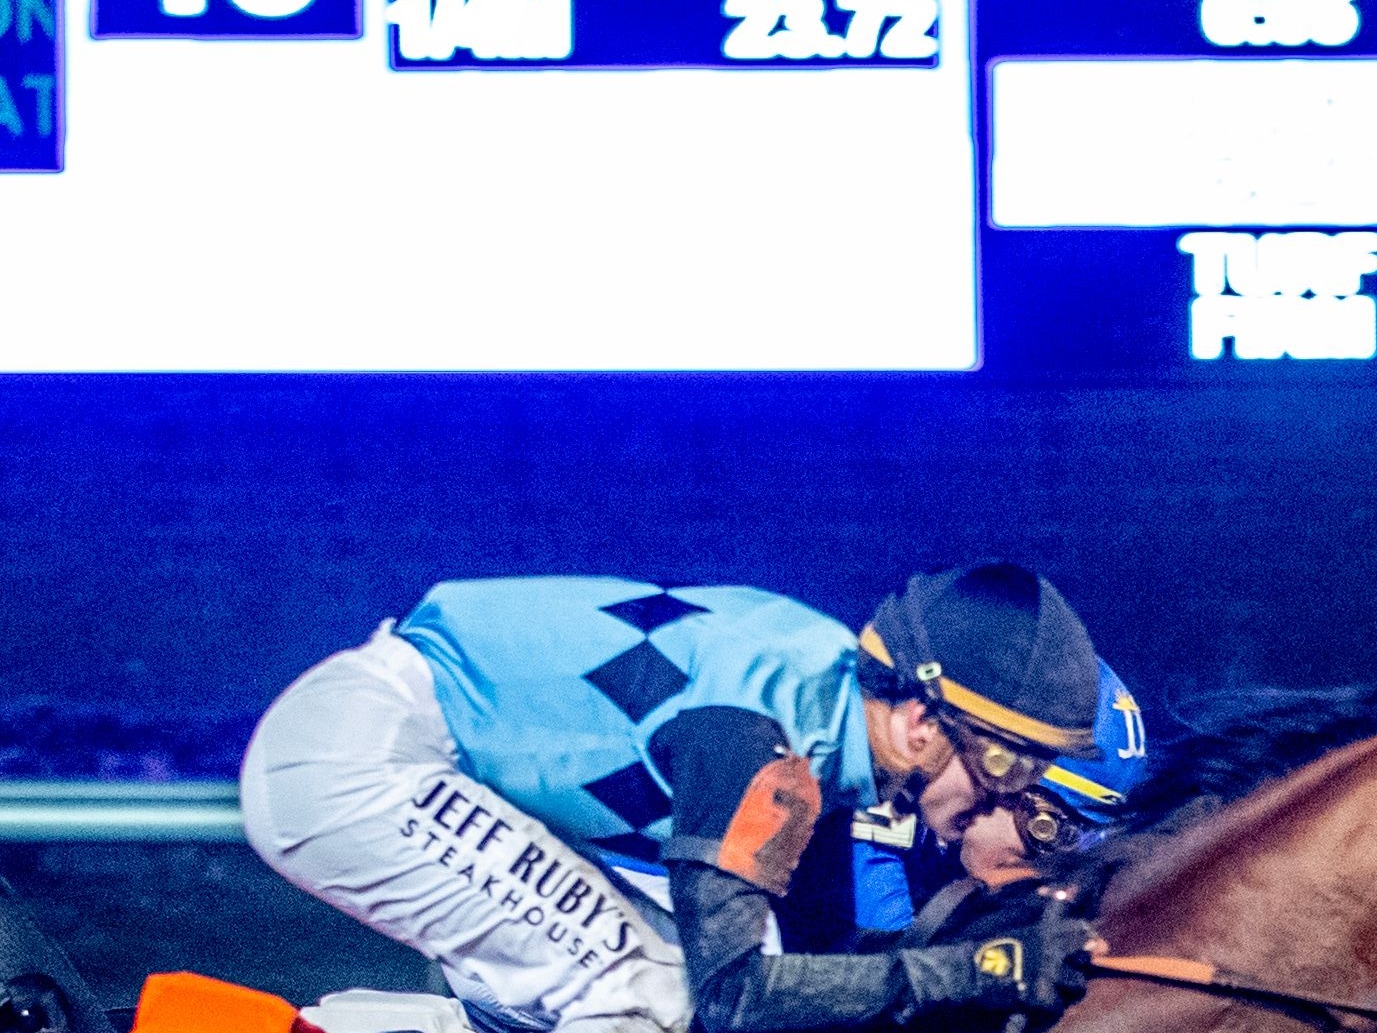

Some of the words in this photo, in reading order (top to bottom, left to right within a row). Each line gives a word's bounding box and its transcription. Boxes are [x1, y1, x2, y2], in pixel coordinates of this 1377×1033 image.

[400, 817, 604, 970] STEAKHOUSE
[411, 780, 514, 853] JEFF
[508, 840, 635, 953] RUBY'S
